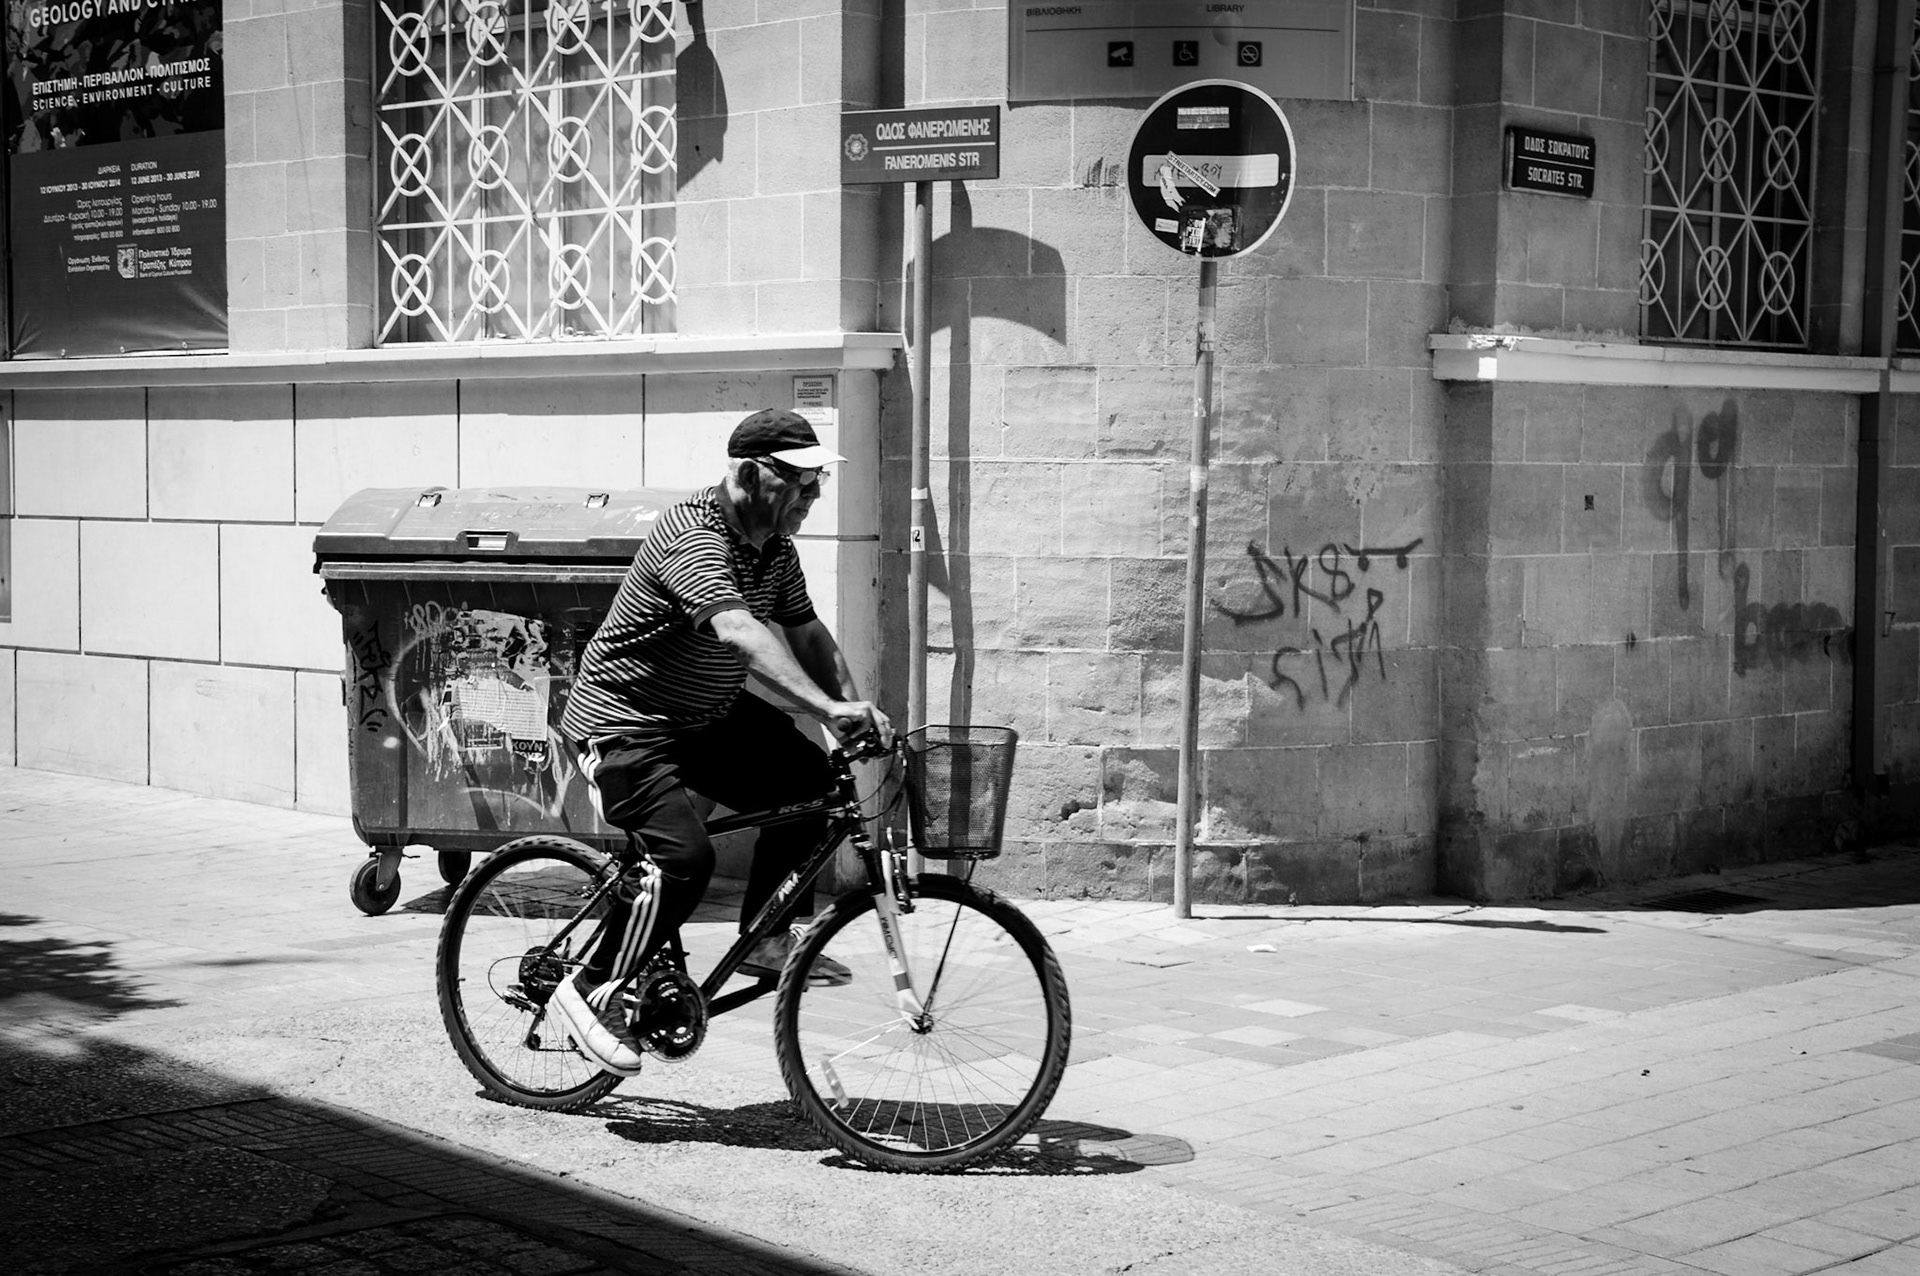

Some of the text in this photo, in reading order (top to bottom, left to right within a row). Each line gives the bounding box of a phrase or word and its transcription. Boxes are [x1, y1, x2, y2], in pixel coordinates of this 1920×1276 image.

[30, 0, 102, 28] GEOLOGY
[1026, 6, 1082, 17] ΒΙΒΛΙΟΘΗΚΗ
[1206, 4, 1245, 13] LIBRARY
[32, 77, 78, 96] ΕΠΙΣΤΗΜΗ
[83, 67, 144, 88] ΠΕΡΙΒΑΛΛΟΝ
[150, 57, 211, 78] ΠΟΛΙΤΙΣΜΟΣ
[32, 95, 75, 111] SCIENCE
[82, 84, 153, 104] ENVIRONMENT
[163, 76, 211, 93] CULTURE
[876, 118, 991, 141] ΟΔΟΣ ΦΑΝΕΡΩΜΕΝΗΣ
[1524, 136, 1590, 160] ΟΔΟΣ ΣΩΚΡΑΤΟΥΣ
[130, 161, 158, 172] DURATION
[884, 152, 980, 170] FANEROMENIS STR
[1527, 166, 1565, 186] SOCRATES
[131, 193, 172, 204] Opening hours
[131, 206, 155, 216] Monday
[159, 202, 181, 213] Sunday
[182, 201, 197, 211] 10.00
[201, 199, 217, 209] 19.00
[914, 529, 921, 542] 2
